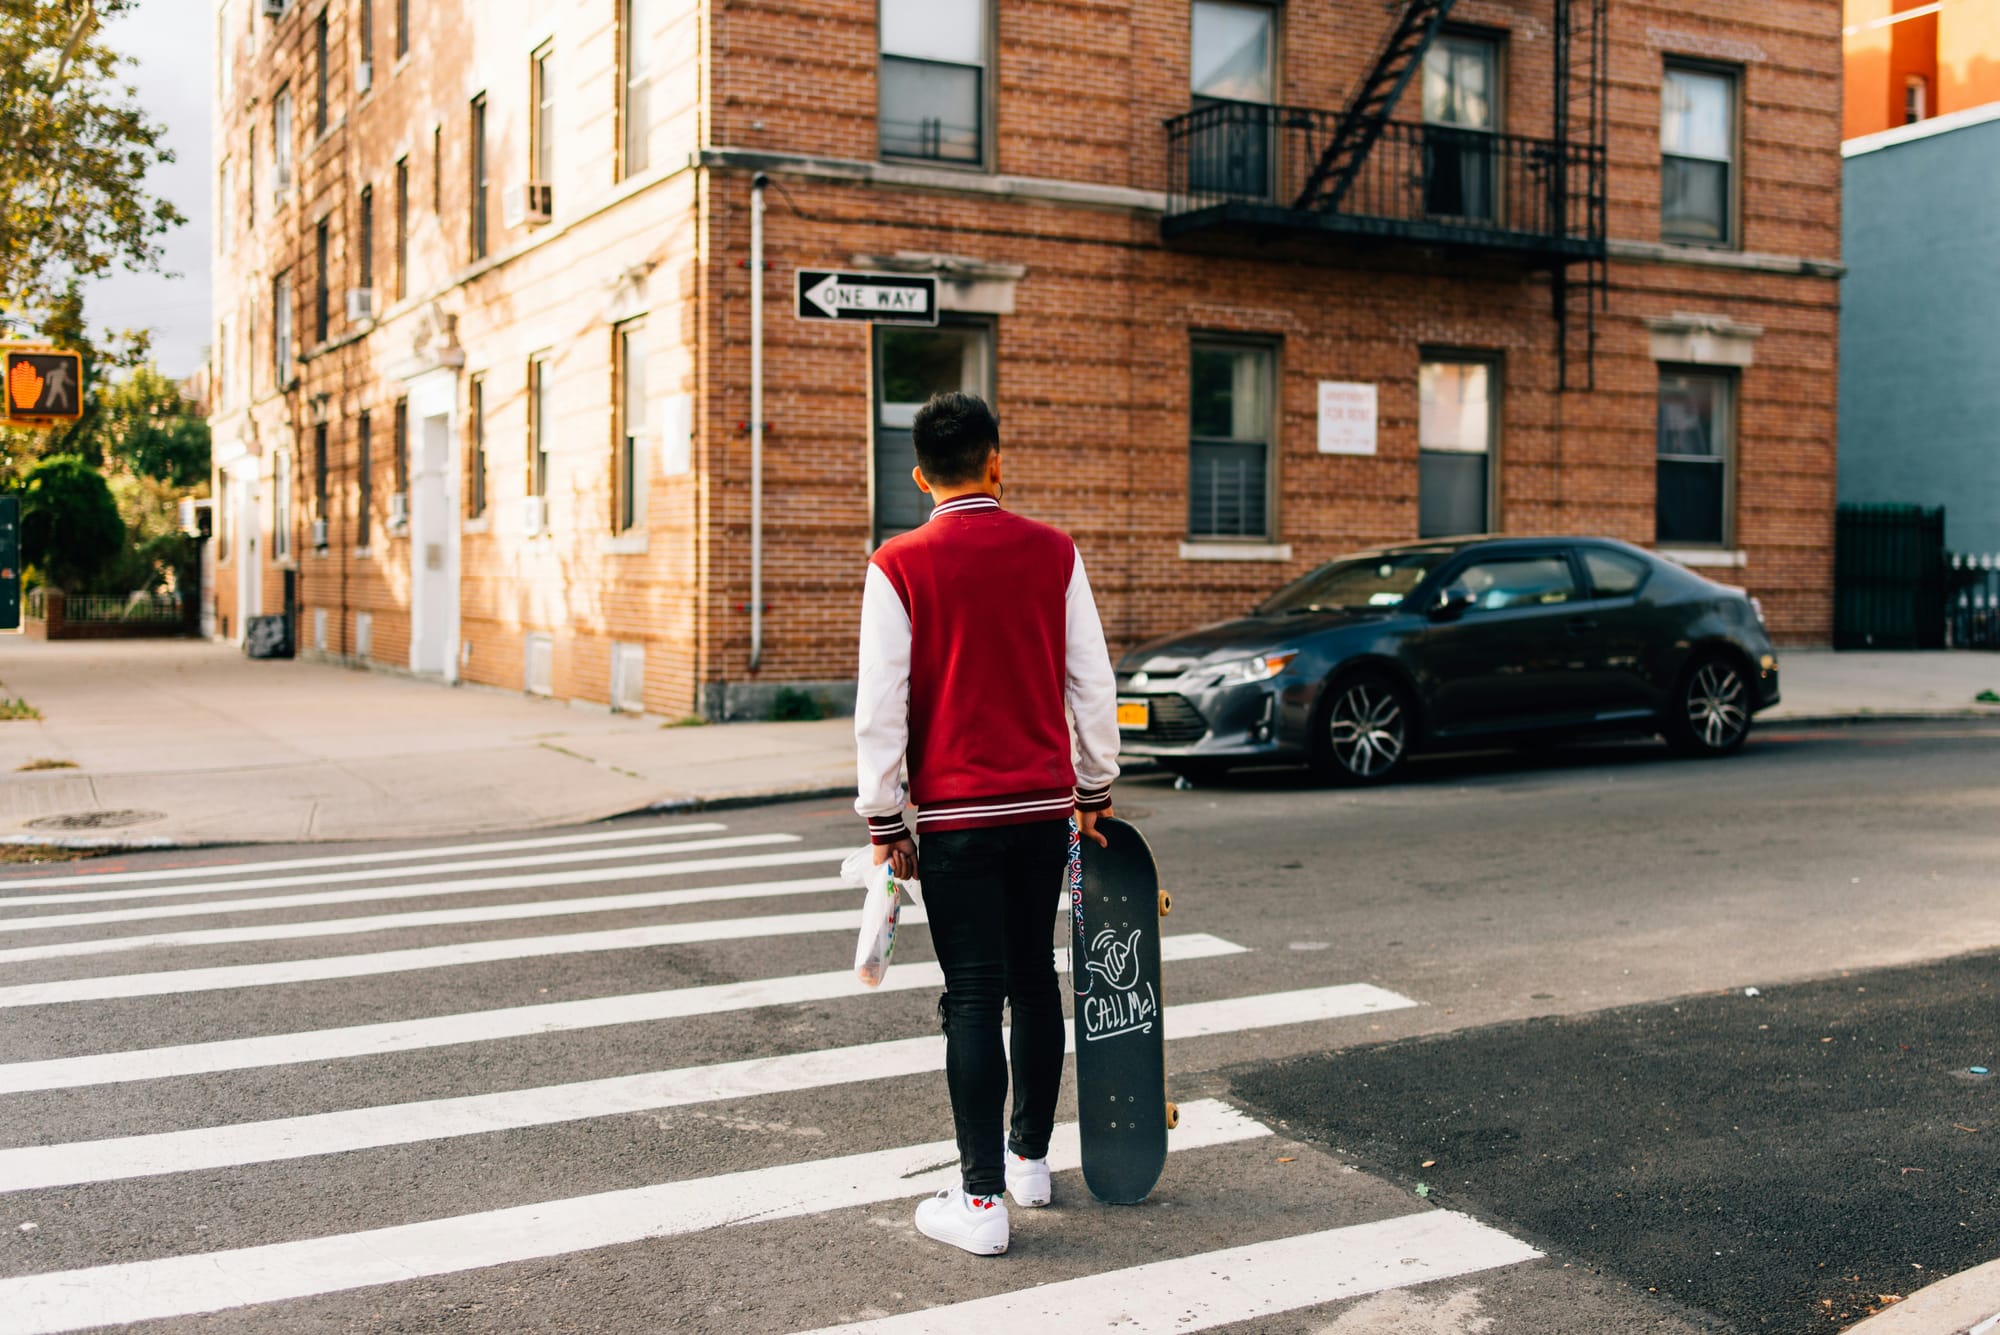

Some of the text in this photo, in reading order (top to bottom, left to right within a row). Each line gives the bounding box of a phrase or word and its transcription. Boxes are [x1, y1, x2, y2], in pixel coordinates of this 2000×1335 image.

[823, 286, 917, 310] ONE WAY
[1084, 994, 1128, 1033] CALL
